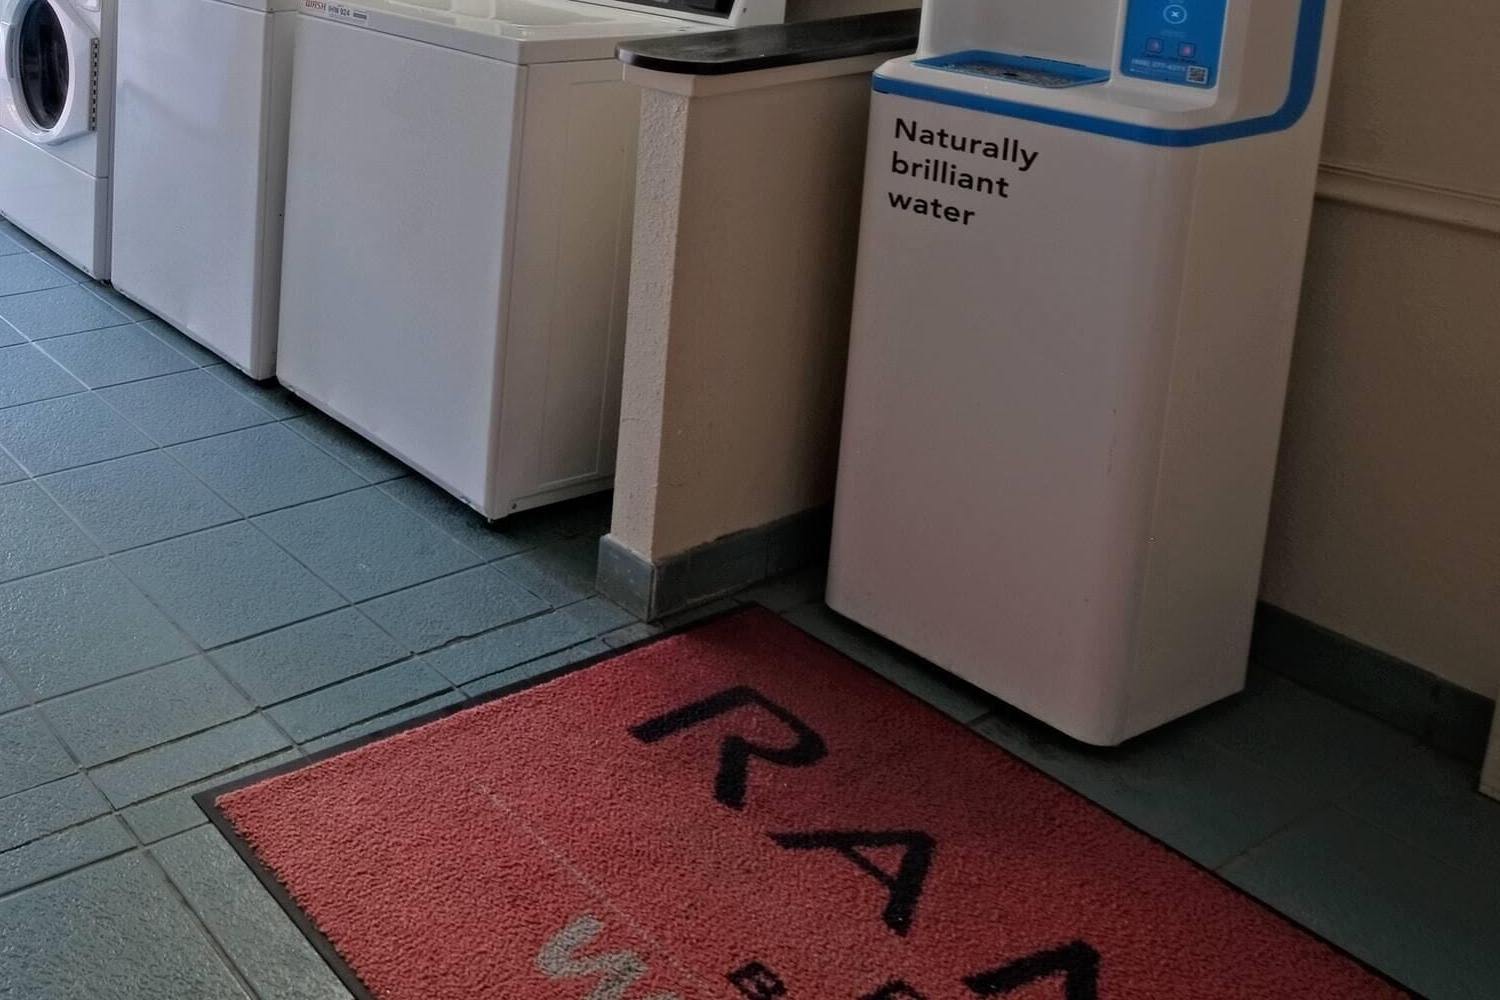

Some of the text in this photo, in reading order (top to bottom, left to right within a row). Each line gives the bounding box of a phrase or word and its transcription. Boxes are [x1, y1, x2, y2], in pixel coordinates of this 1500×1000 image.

[894, 117, 1040, 172] Naturally
[890, 150, 1011, 199] brilliant
[887, 191, 977, 227] water
